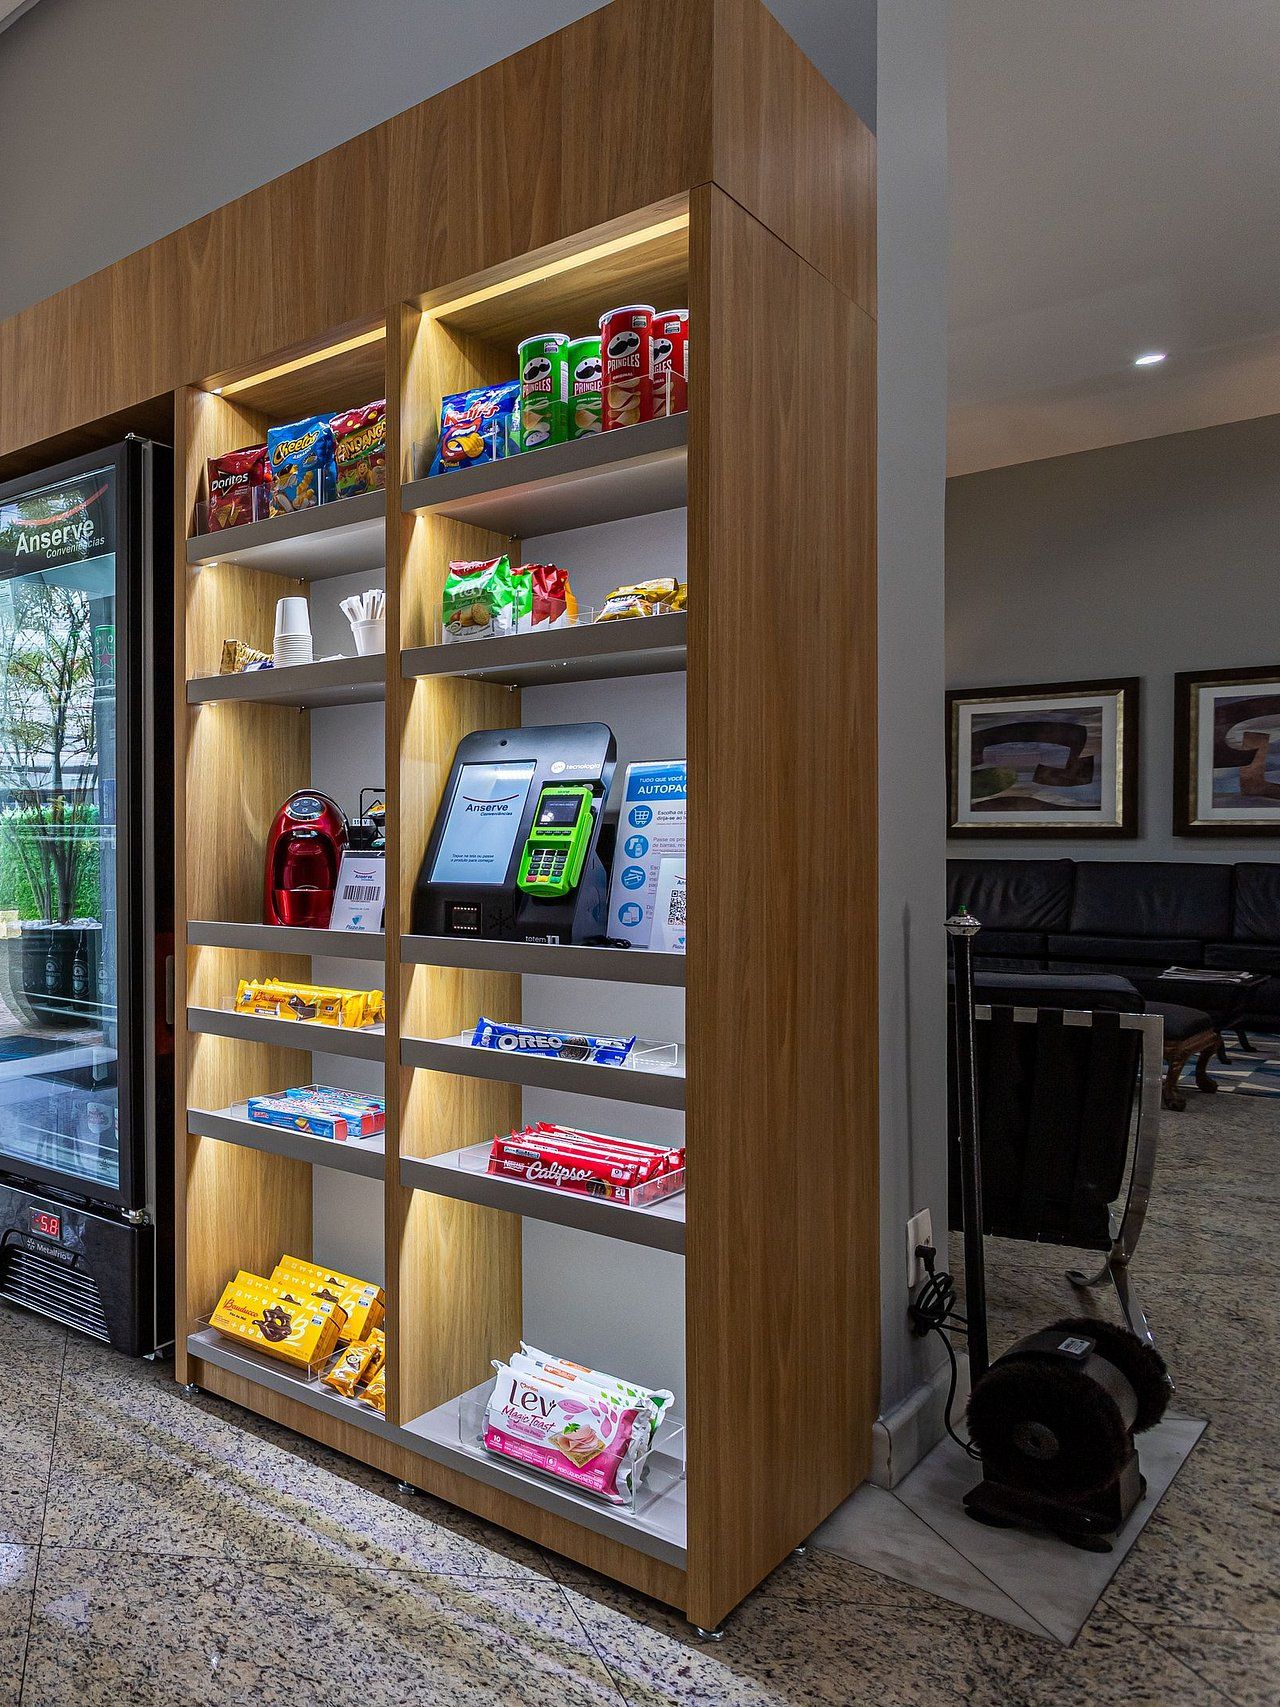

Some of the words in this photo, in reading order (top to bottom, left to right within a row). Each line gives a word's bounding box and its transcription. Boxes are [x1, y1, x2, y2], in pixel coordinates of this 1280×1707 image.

[607, 354, 640, 375] PRINGLES
[272, 430, 320, 466] Cheetos
[211, 473, 249, 491] Doritos
[15, 519, 95, 557] Anserve
[46, 536, 106, 559] Convenicias
[465, 803, 509, 813] Anserve
[497, 1033, 563, 1051] OREO
[525, 1160, 593, 1187] Calipso
[36, 1243, 67, 1260] Metalfrio
[223, 1297, 259, 1318] Bauducco
[500, 1404, 530, 1424] Magic
[528, 1414, 557, 1433] Toast
[493, 1434, 501, 1443] 10
